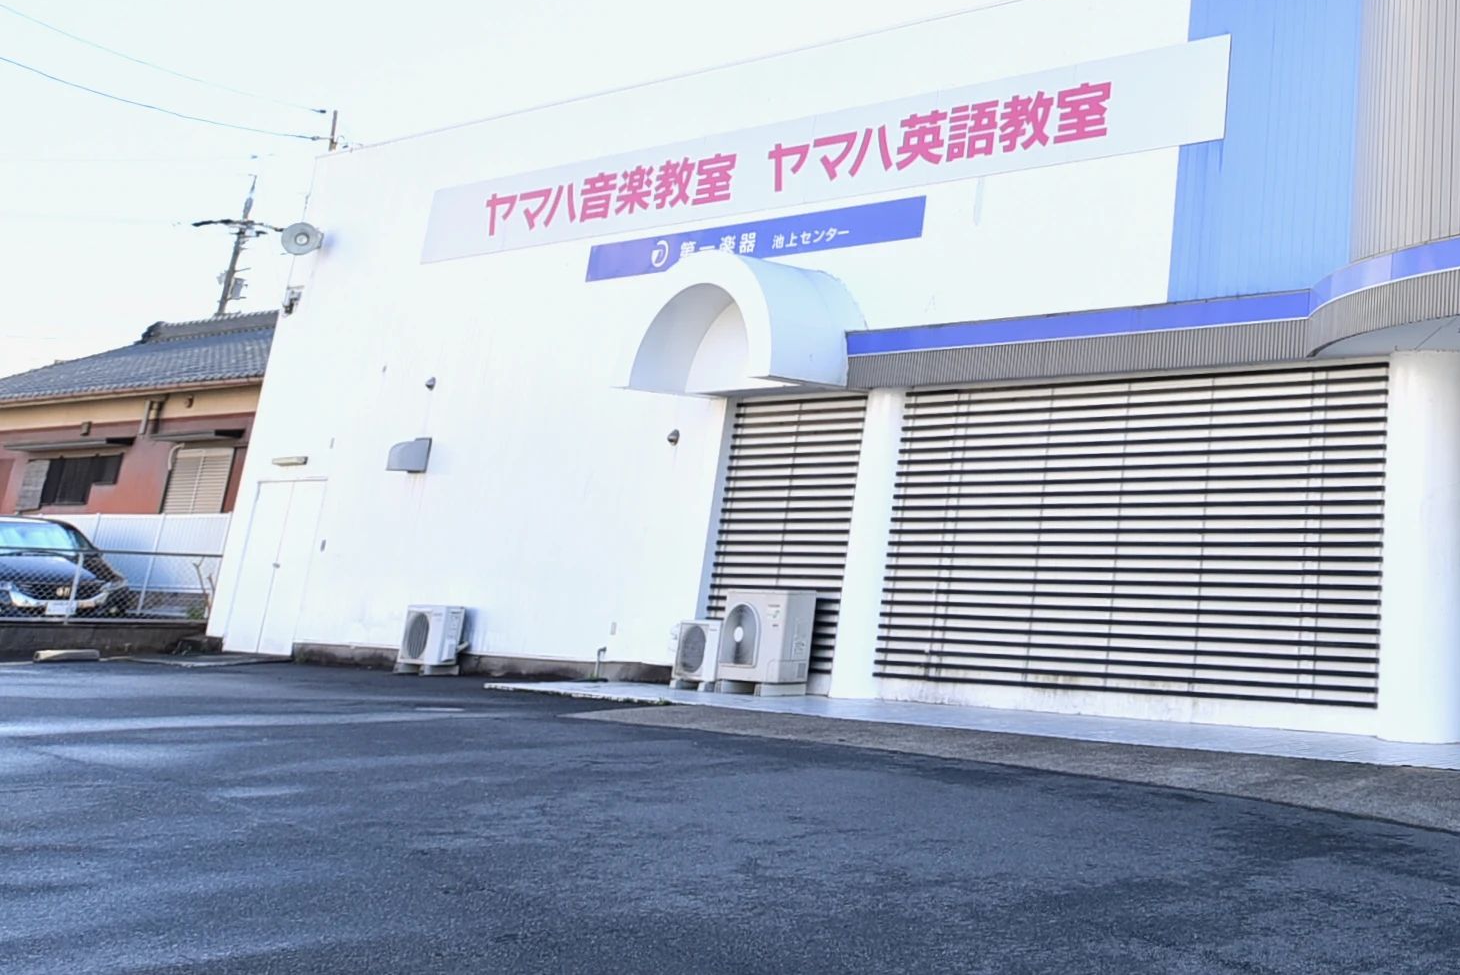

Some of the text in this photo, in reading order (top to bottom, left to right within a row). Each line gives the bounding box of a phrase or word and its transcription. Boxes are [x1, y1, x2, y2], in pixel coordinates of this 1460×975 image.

[485, 81, 1112, 238] ヤマハ音楽教室 ヤマハ英語教室
[680, 227, 849, 258] 第一楽器 池上センター
